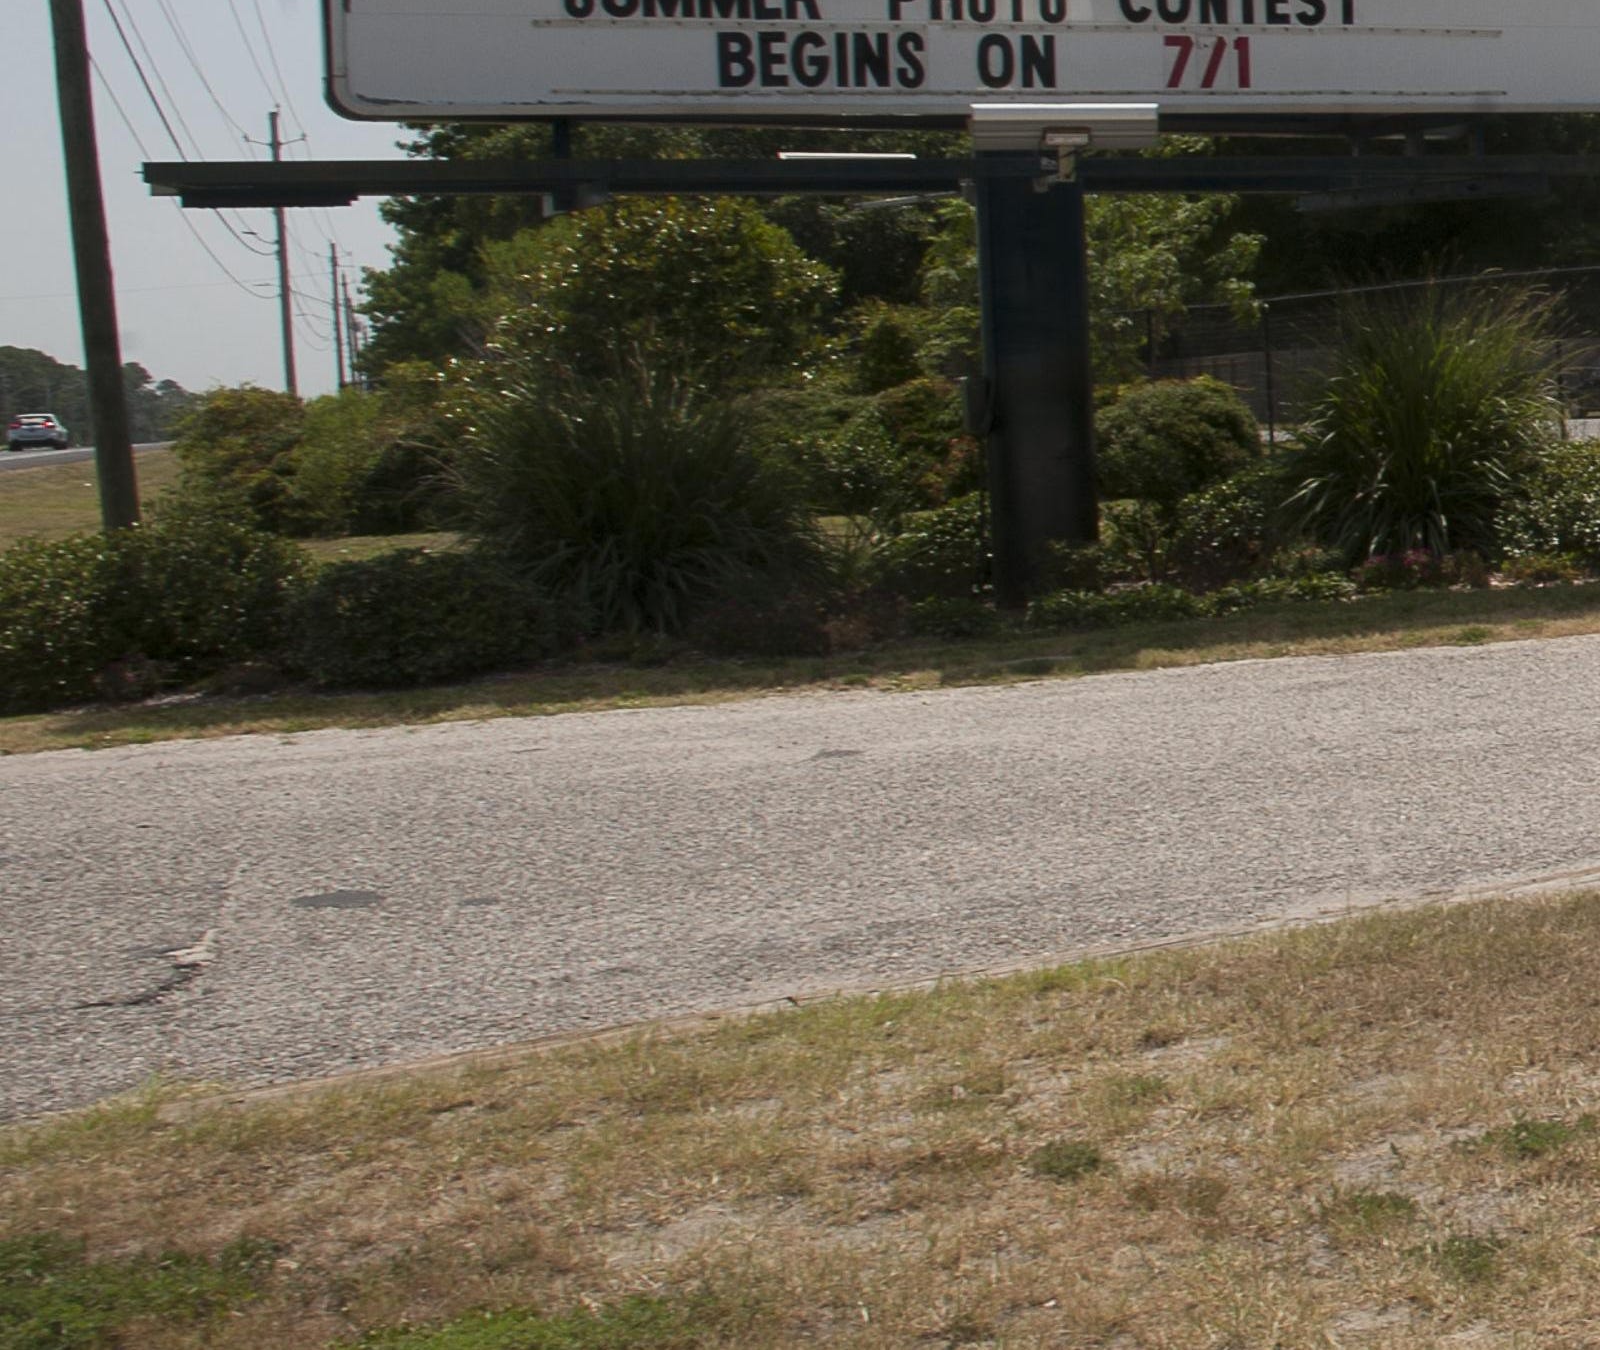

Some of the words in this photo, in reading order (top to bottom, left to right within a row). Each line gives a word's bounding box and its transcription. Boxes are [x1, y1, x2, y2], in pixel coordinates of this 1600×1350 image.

[717, 30, 925, 89] BEGINS
[976, 33, 1057, 89] ON
[1163, 35, 1250, 89] 7/1
